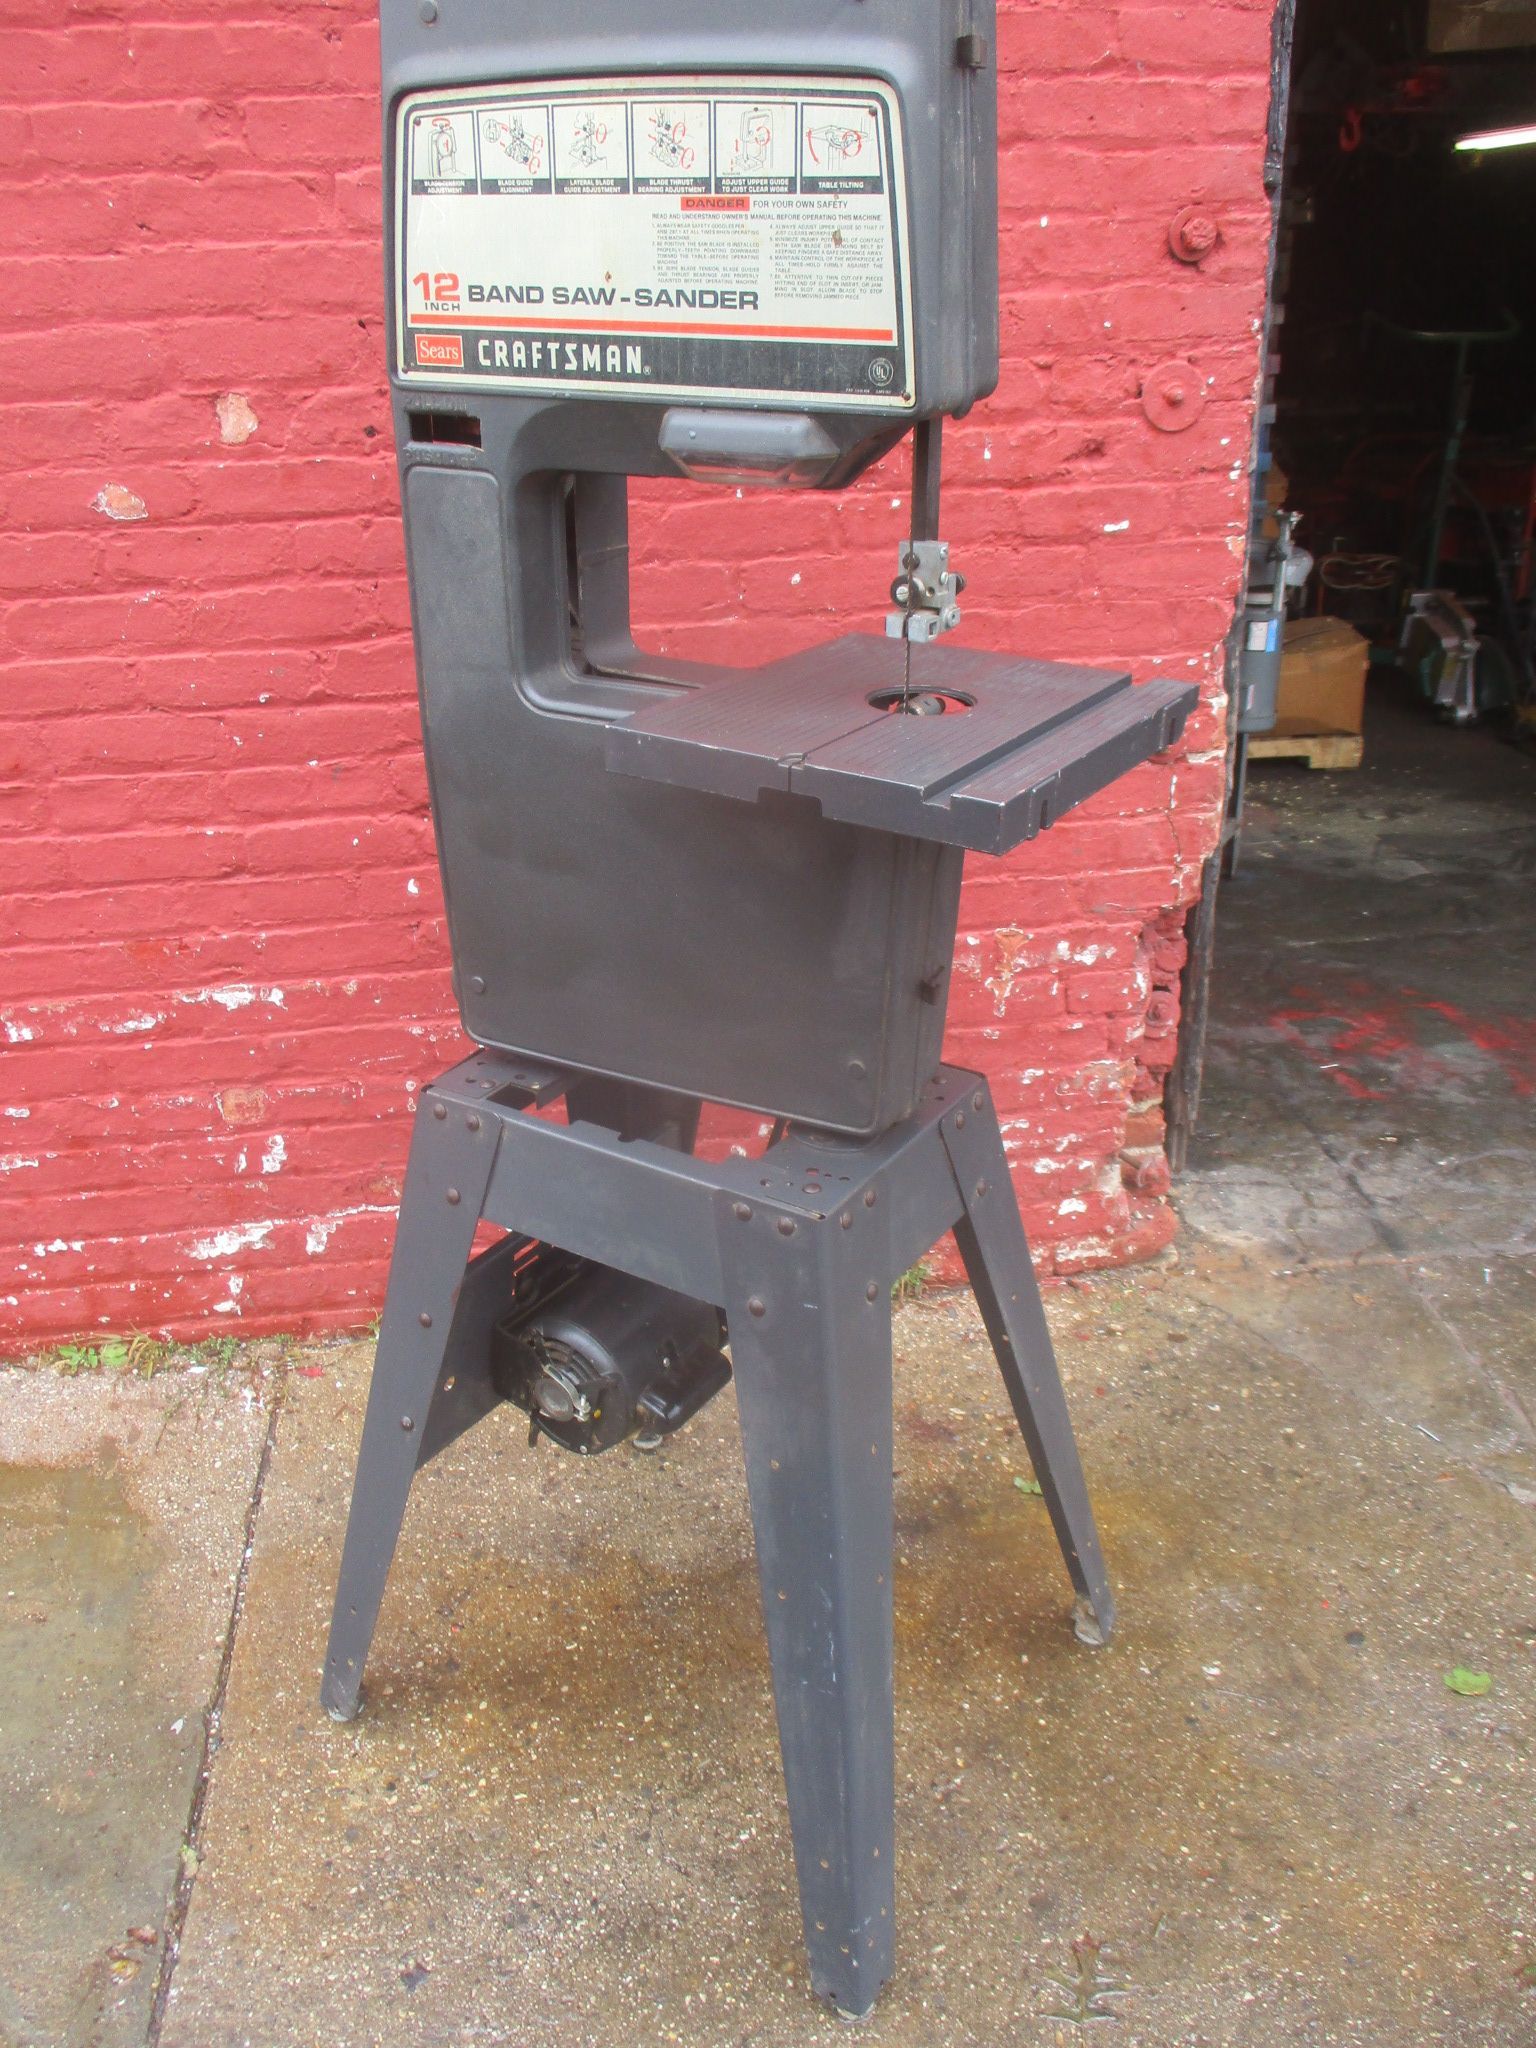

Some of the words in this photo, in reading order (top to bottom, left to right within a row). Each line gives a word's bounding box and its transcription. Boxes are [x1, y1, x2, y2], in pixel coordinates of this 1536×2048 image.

[498, 179, 516, 187] BLADE
[517, 179, 533, 187] GUIDE
[570, 179, 593, 187] LATERAL
[595, 179, 614, 187] BLADE
[500, 186, 532, 194] ALIGNMENT
[564, 186, 581, 194] GUIDE
[582, 186, 620, 194] ADJUSTMENT
[686, 199, 746, 208] DANGER
[754, 200, 770, 209] FOR
[772, 200, 793, 209] YOUR
[796, 201, 814, 209] OWN
[817, 201, 848, 209] SAFETY
[412, 272, 460, 301] 12
[468, 285, 544, 305] BAND
[425, 302, 460, 312] INCH
[420, 339, 458, 360] Sears
